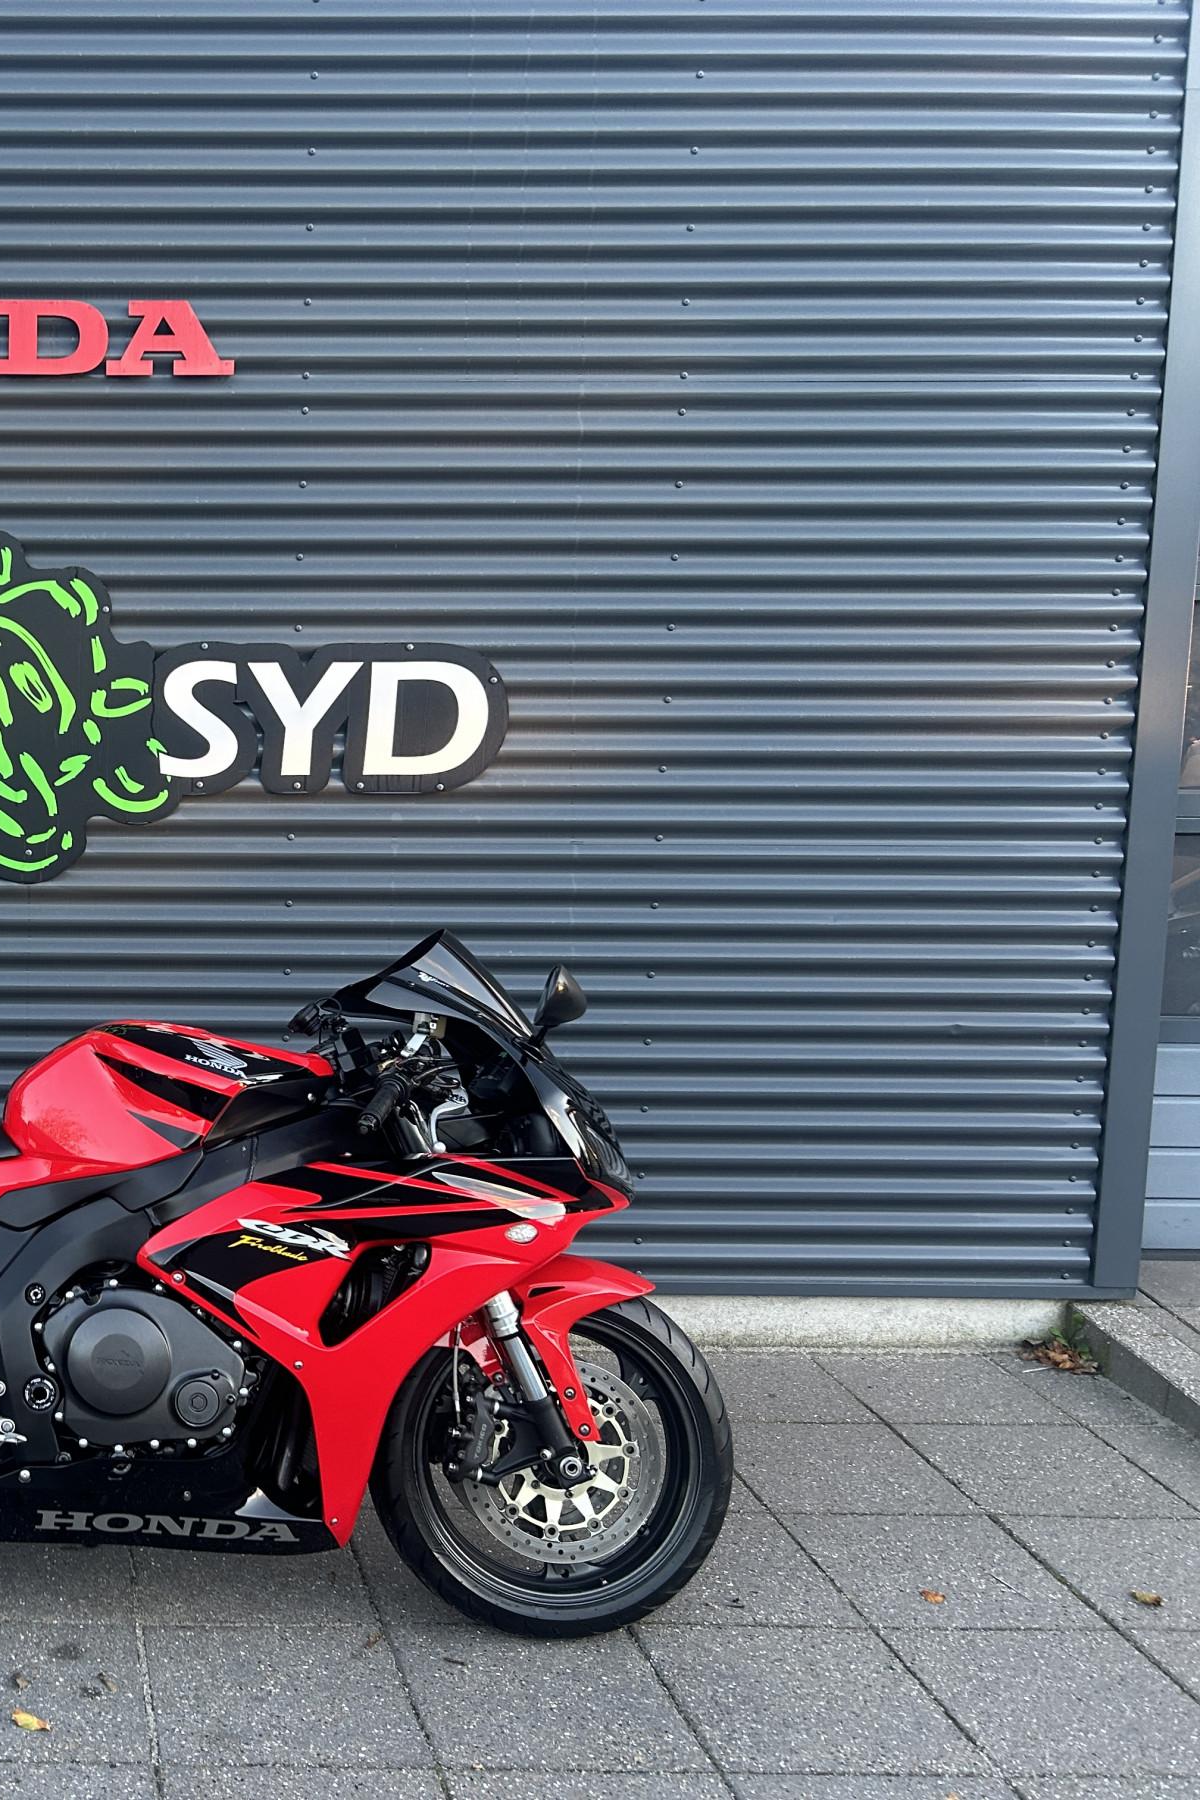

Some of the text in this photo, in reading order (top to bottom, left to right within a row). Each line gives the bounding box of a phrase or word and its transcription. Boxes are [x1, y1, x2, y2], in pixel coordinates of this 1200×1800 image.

[158, 660, 489, 778] SYD
[184, 1054, 249, 1080] HONDA
[227, 1234, 308, 1261] Fireblade
[236, 1218, 353, 1261] CBR
[34, 1509, 301, 1542] HONDA
